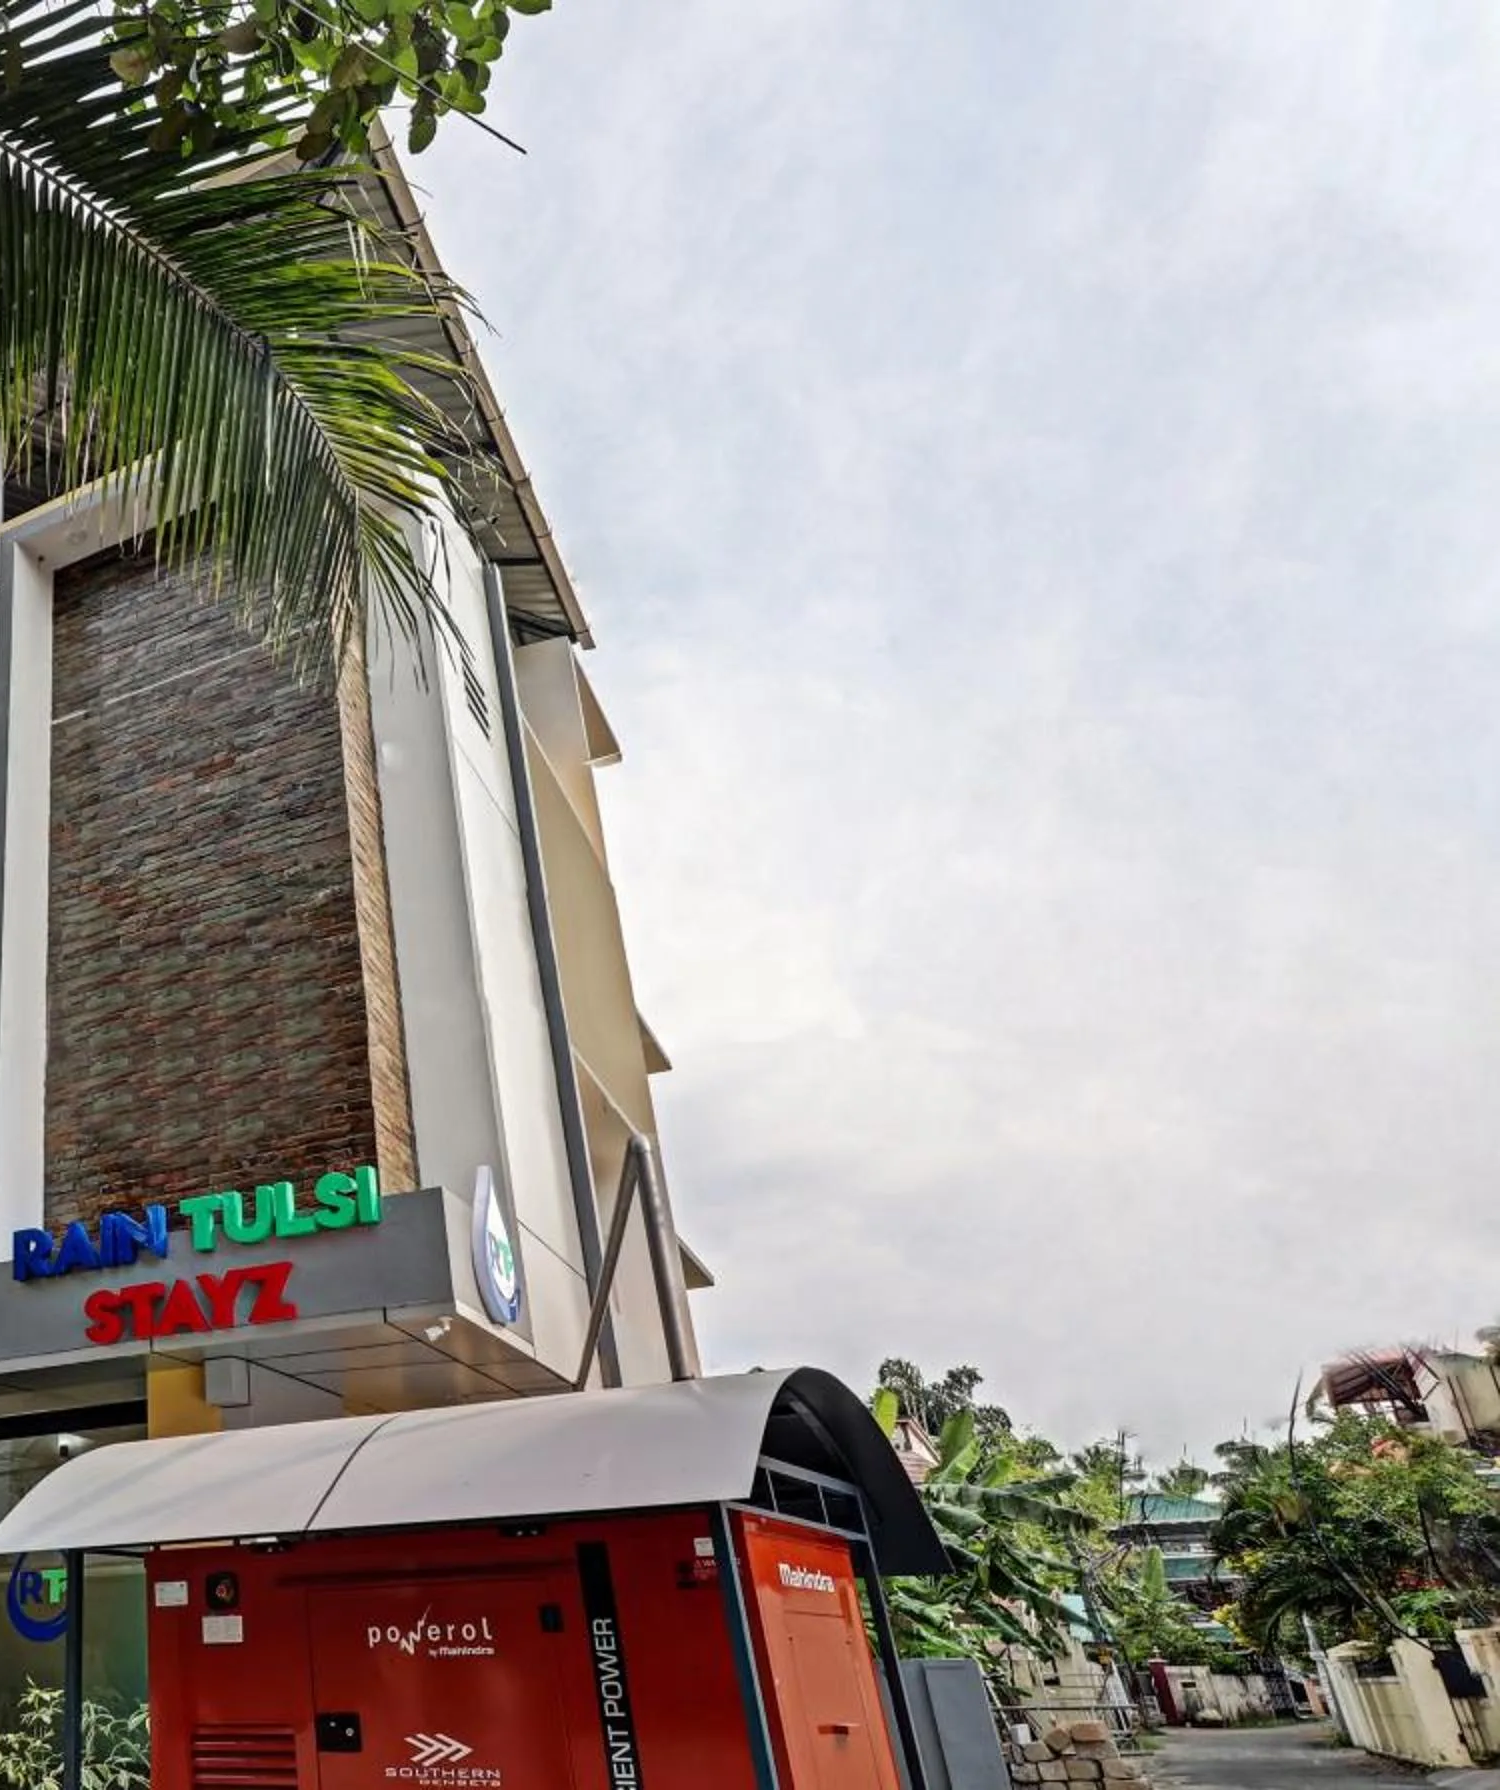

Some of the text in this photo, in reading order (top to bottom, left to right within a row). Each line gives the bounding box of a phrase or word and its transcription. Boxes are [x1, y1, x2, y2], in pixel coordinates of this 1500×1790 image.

[13, 1165, 382, 1281] RAIN TULSI
[84, 1262, 297, 1345] STAYZ
[592, 1617, 626, 1717] POWER
[385, 1767, 501, 1779] SOUTHERN
